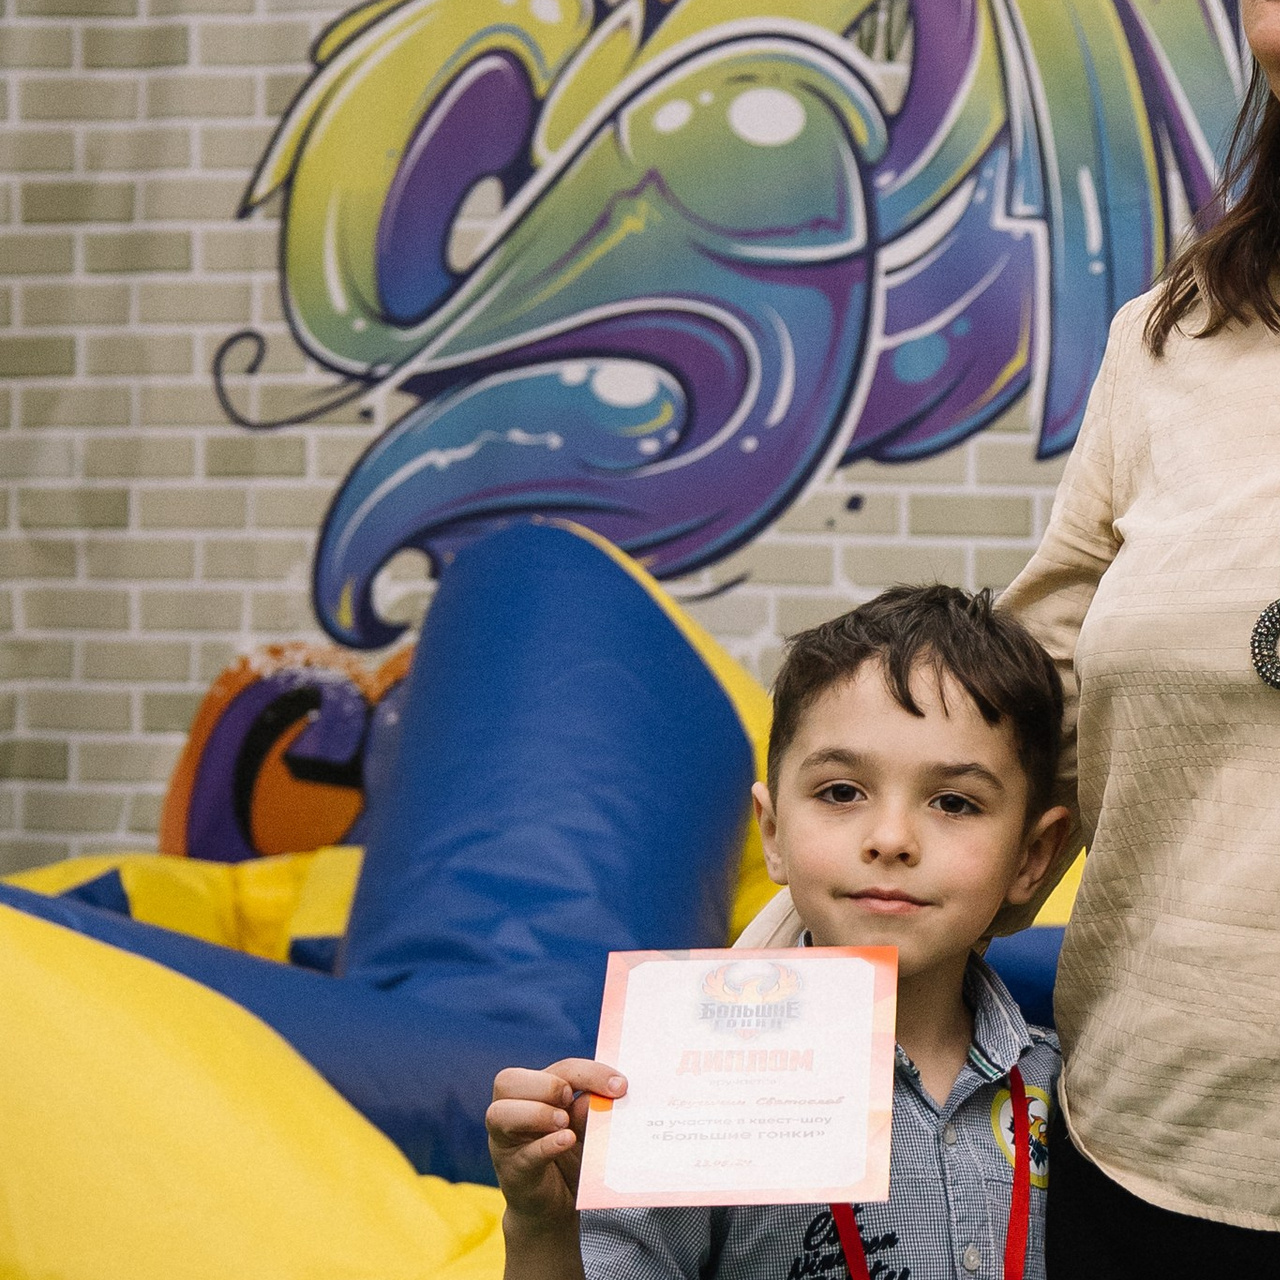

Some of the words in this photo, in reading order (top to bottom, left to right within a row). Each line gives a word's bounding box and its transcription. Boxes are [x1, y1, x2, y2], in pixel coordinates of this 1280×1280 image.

[699, 1001, 800, 1020] БОЛЬШИЕ
[676, 1048, 815, 1075] ДИПЛОМ
[646, 1118, 665, 1127] за
[668, 1117, 733, 1128] участие
[651, 1130, 752, 1142] «Большие
[758, 1129, 826, 1140] гонки»
